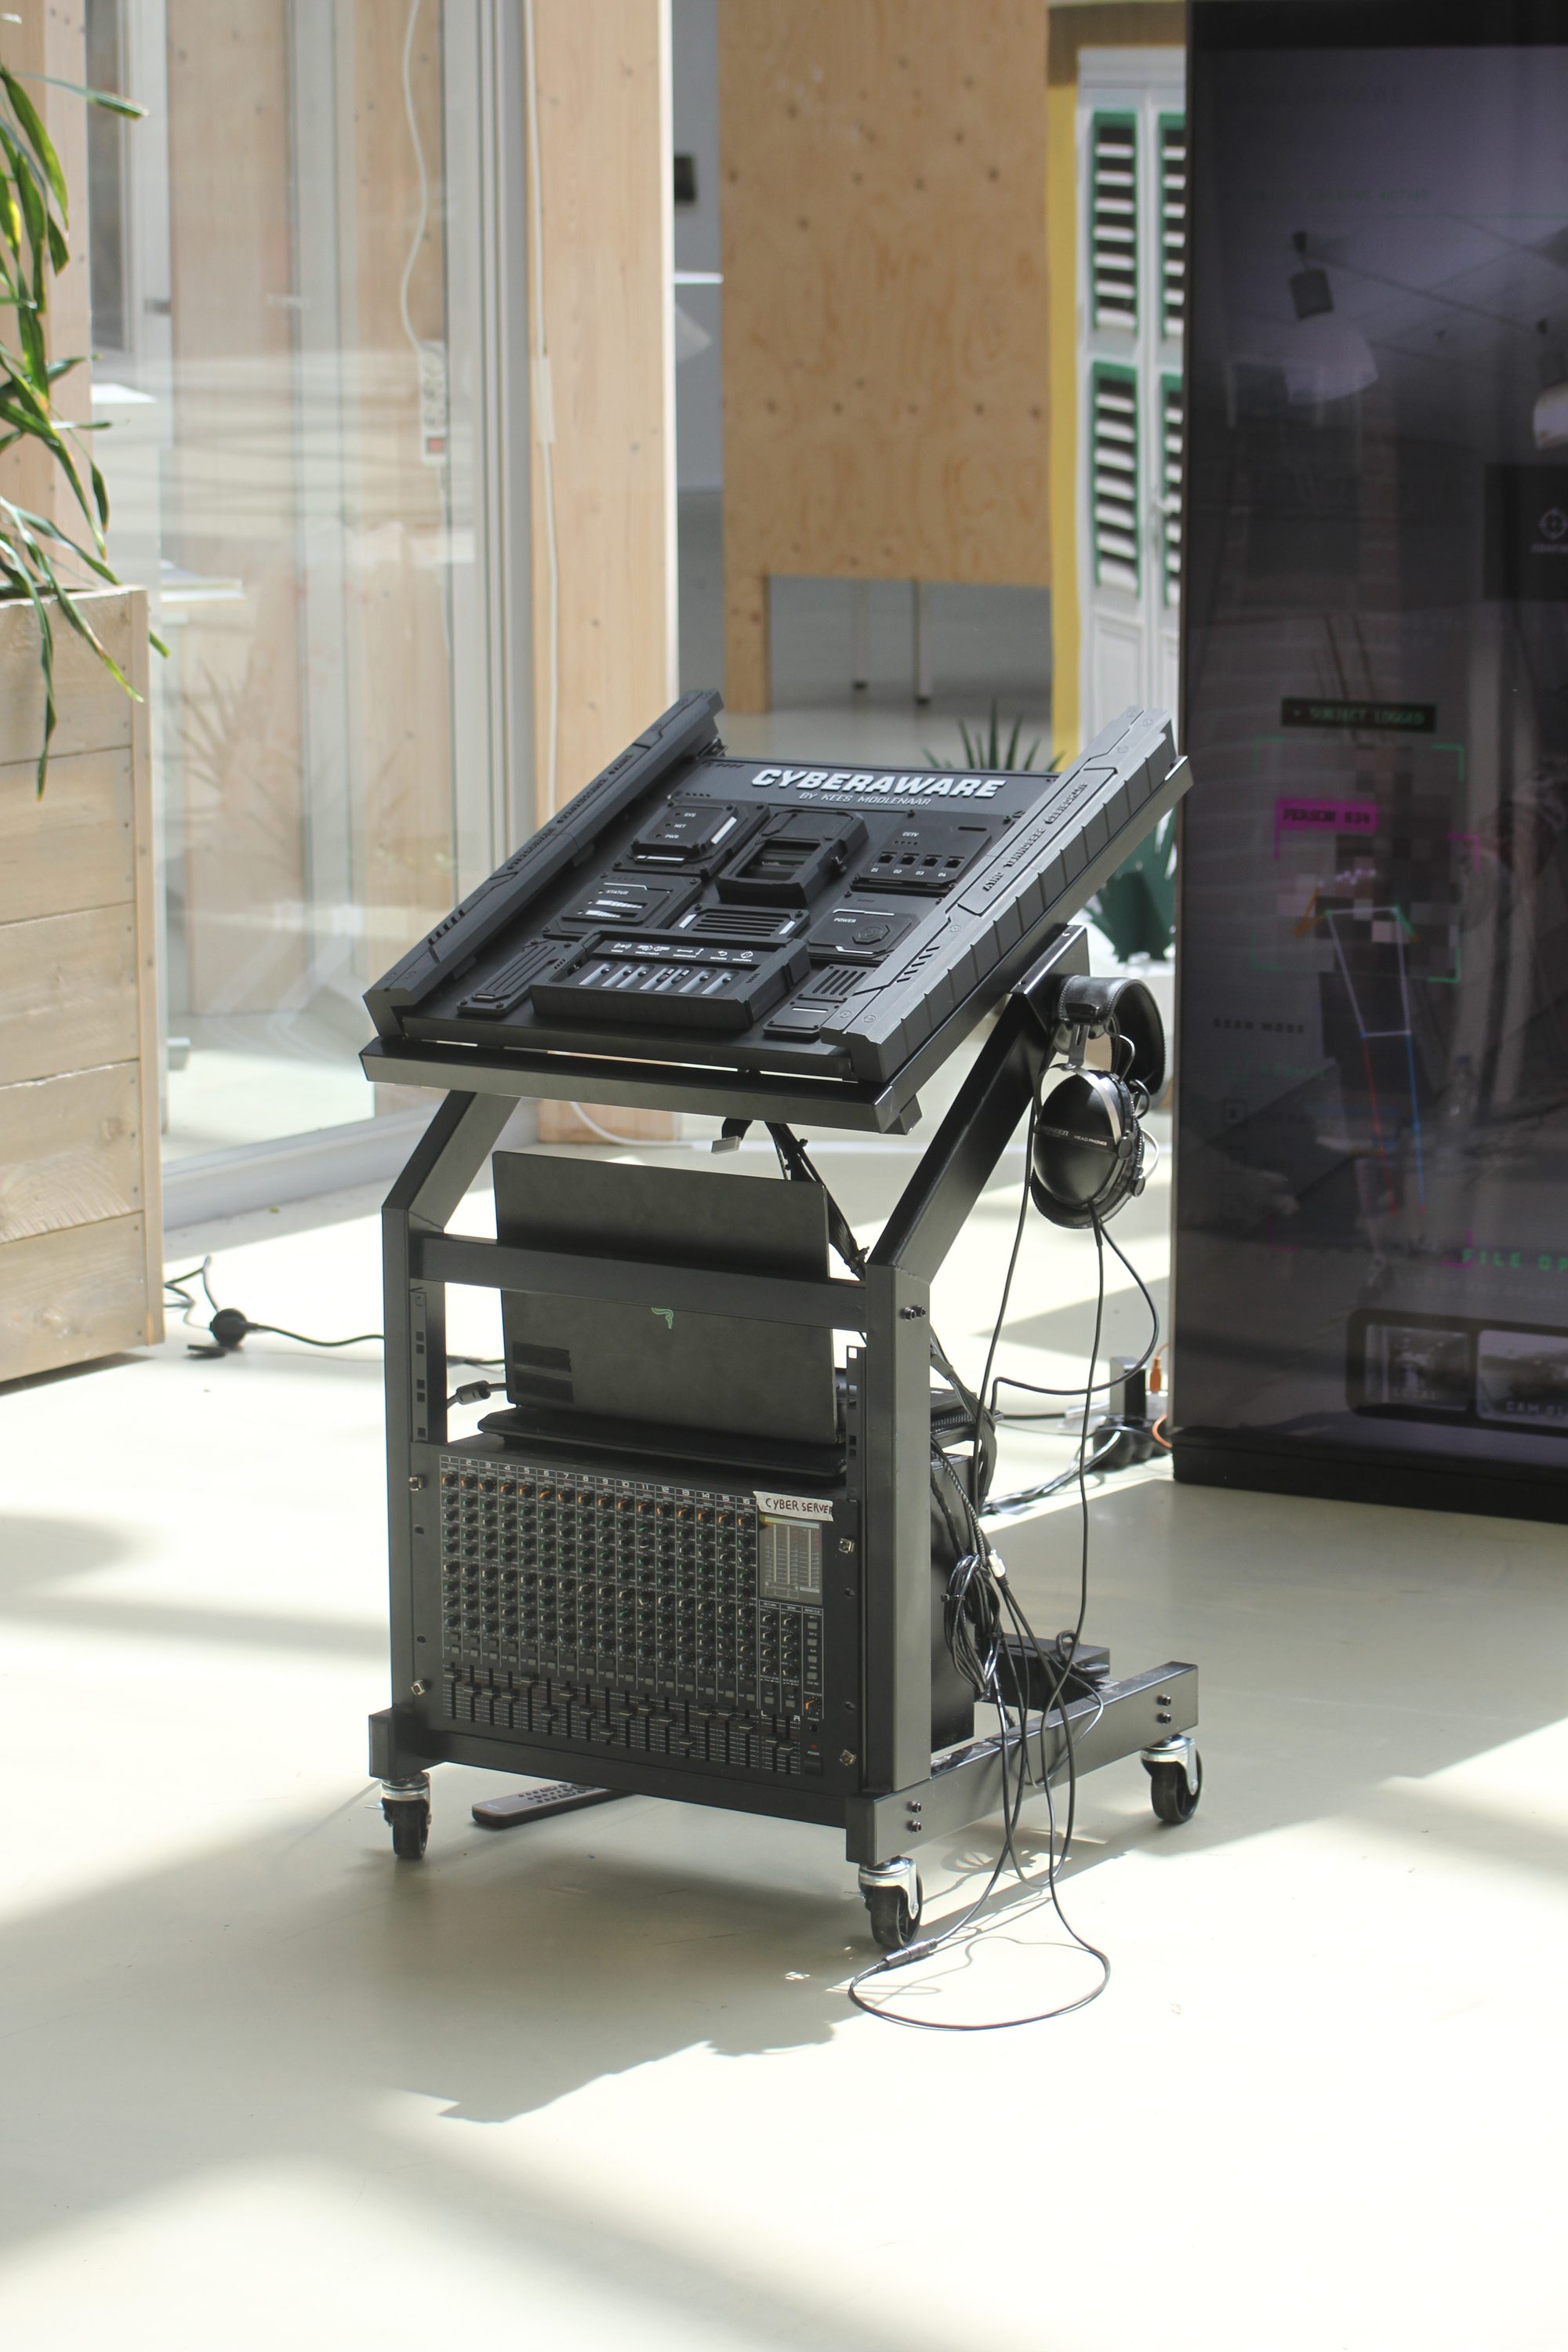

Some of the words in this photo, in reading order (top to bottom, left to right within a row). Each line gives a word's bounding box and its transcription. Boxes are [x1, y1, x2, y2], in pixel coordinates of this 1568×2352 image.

[751, 768, 1007, 798] CYBERAWARE
[821, 793, 853, 803] KEES
[1283, 808, 1336, 822] PERSON
[1462, 1248, 1522, 1269] FILE
[1506, 1401, 1539, 1413] CAM
[765, 1497, 799, 1512] CYBER
